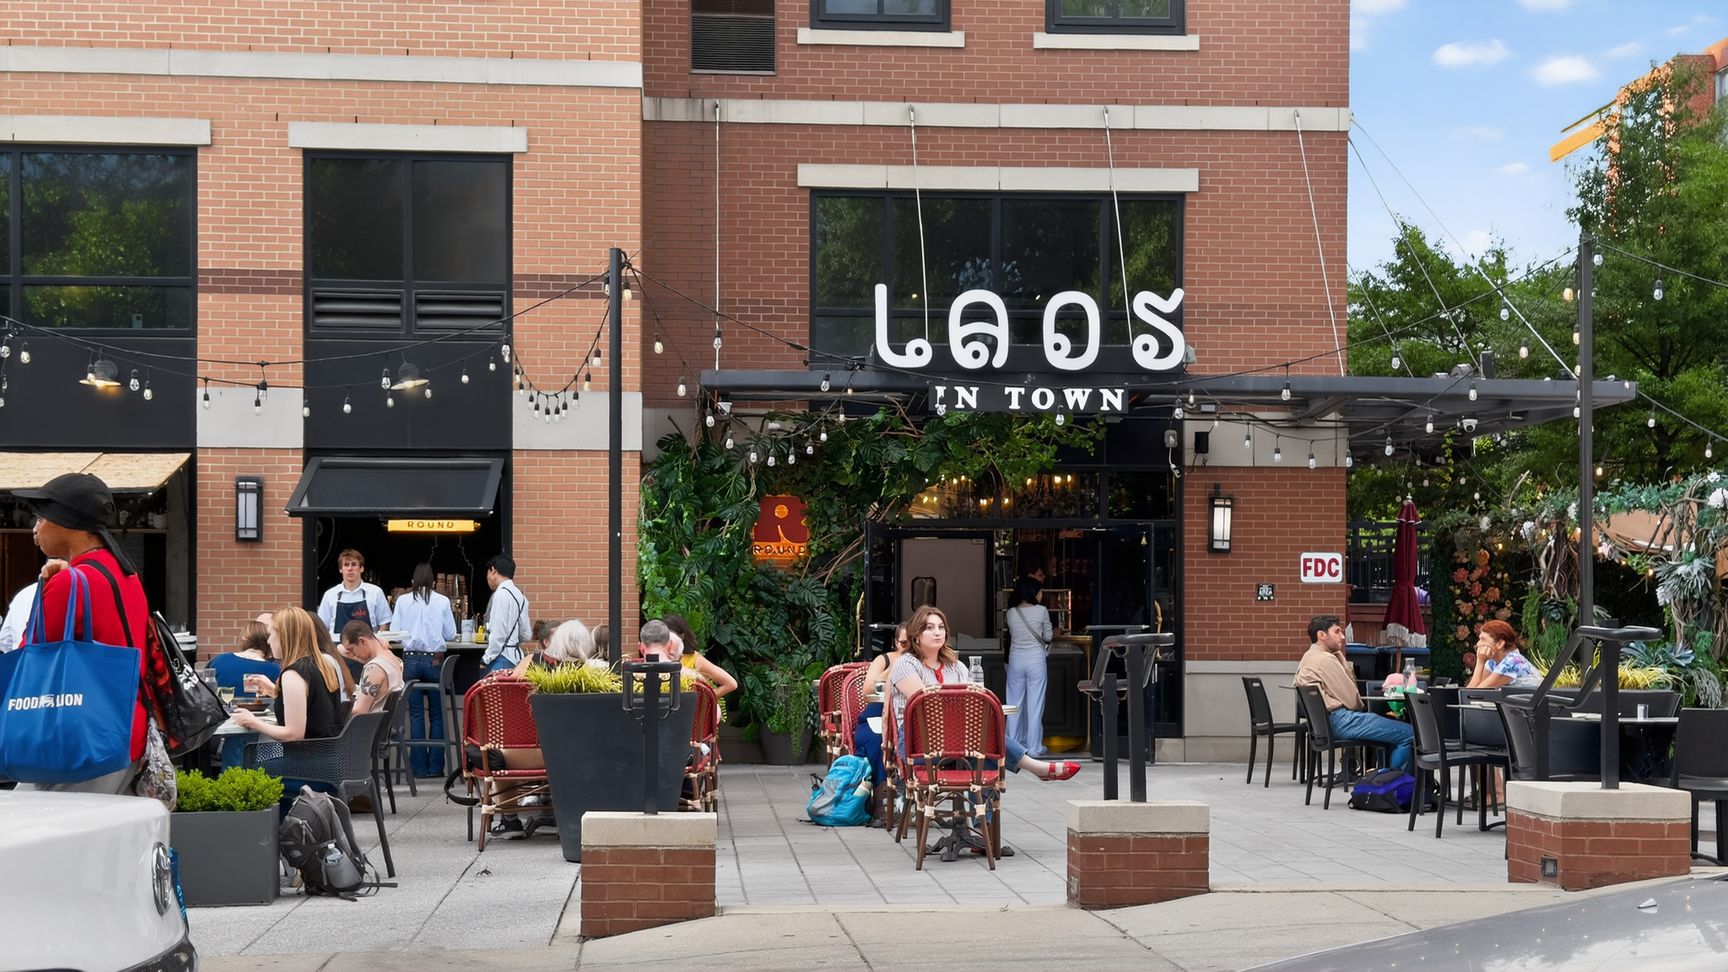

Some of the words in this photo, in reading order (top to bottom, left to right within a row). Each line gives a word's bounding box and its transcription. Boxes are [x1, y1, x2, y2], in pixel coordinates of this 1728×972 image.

[935, 386, 979, 410] IN
[1004, 387, 1125, 411] TOWN
[407, 520, 454, 529] ROUND
[1303, 557, 1340, 578] FDC
[8, 696, 40, 711] FOOD
[56, 693, 83, 707] LION
